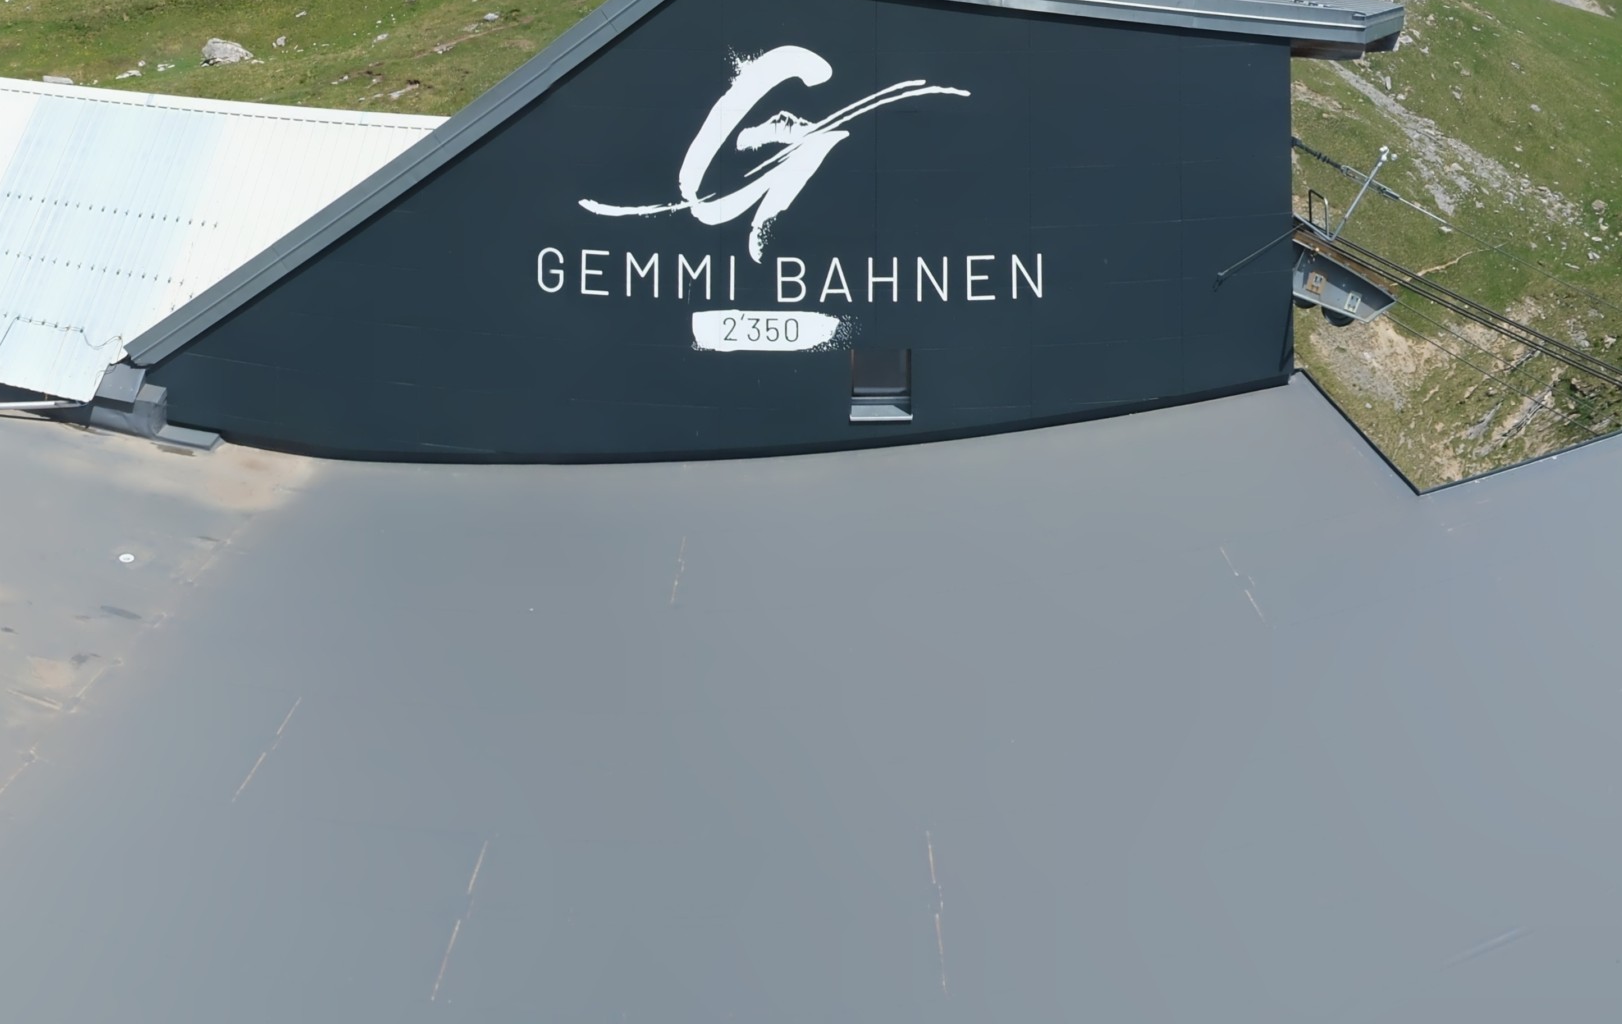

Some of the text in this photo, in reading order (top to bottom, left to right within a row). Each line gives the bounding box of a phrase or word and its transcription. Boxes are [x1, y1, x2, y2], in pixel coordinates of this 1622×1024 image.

[537, 246, 1043, 303] GEMMI BAHNEN
[722, 313, 801, 343] 2'350
